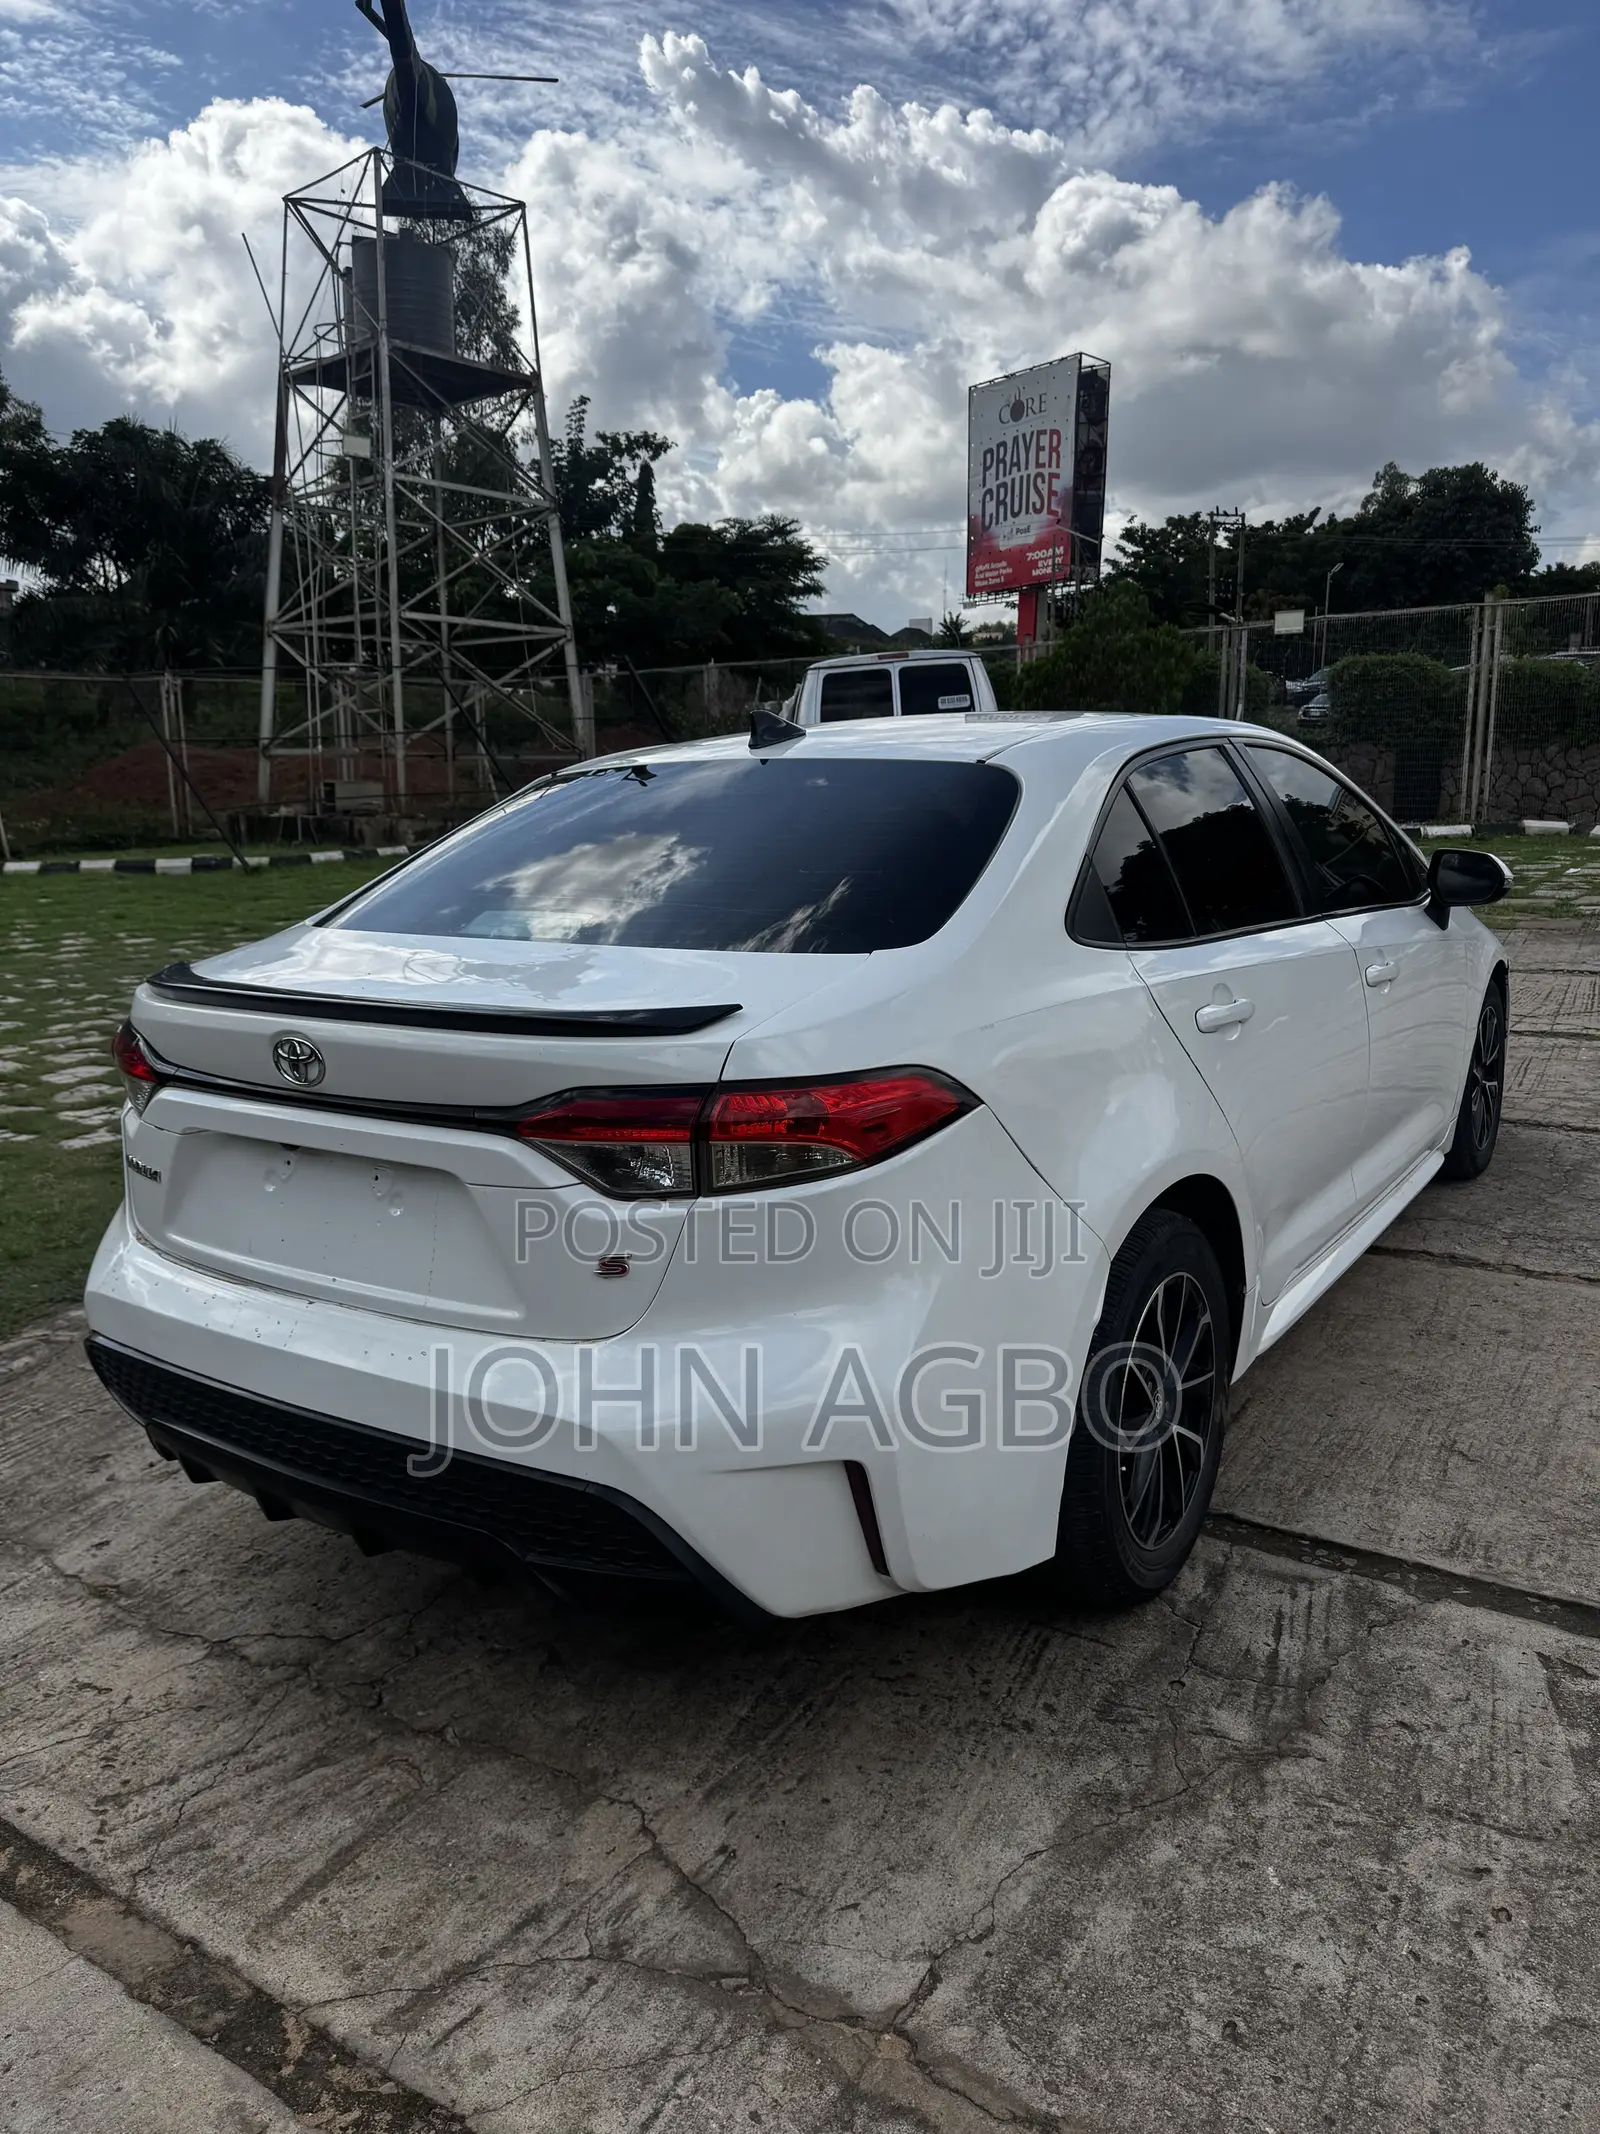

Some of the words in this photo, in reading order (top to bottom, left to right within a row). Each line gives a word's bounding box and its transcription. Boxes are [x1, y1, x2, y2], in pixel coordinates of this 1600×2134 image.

[981, 428, 1062, 489] PRAYER
[980, 472, 1061, 533] CRUISE
[592, 1253, 633, 1278] S
